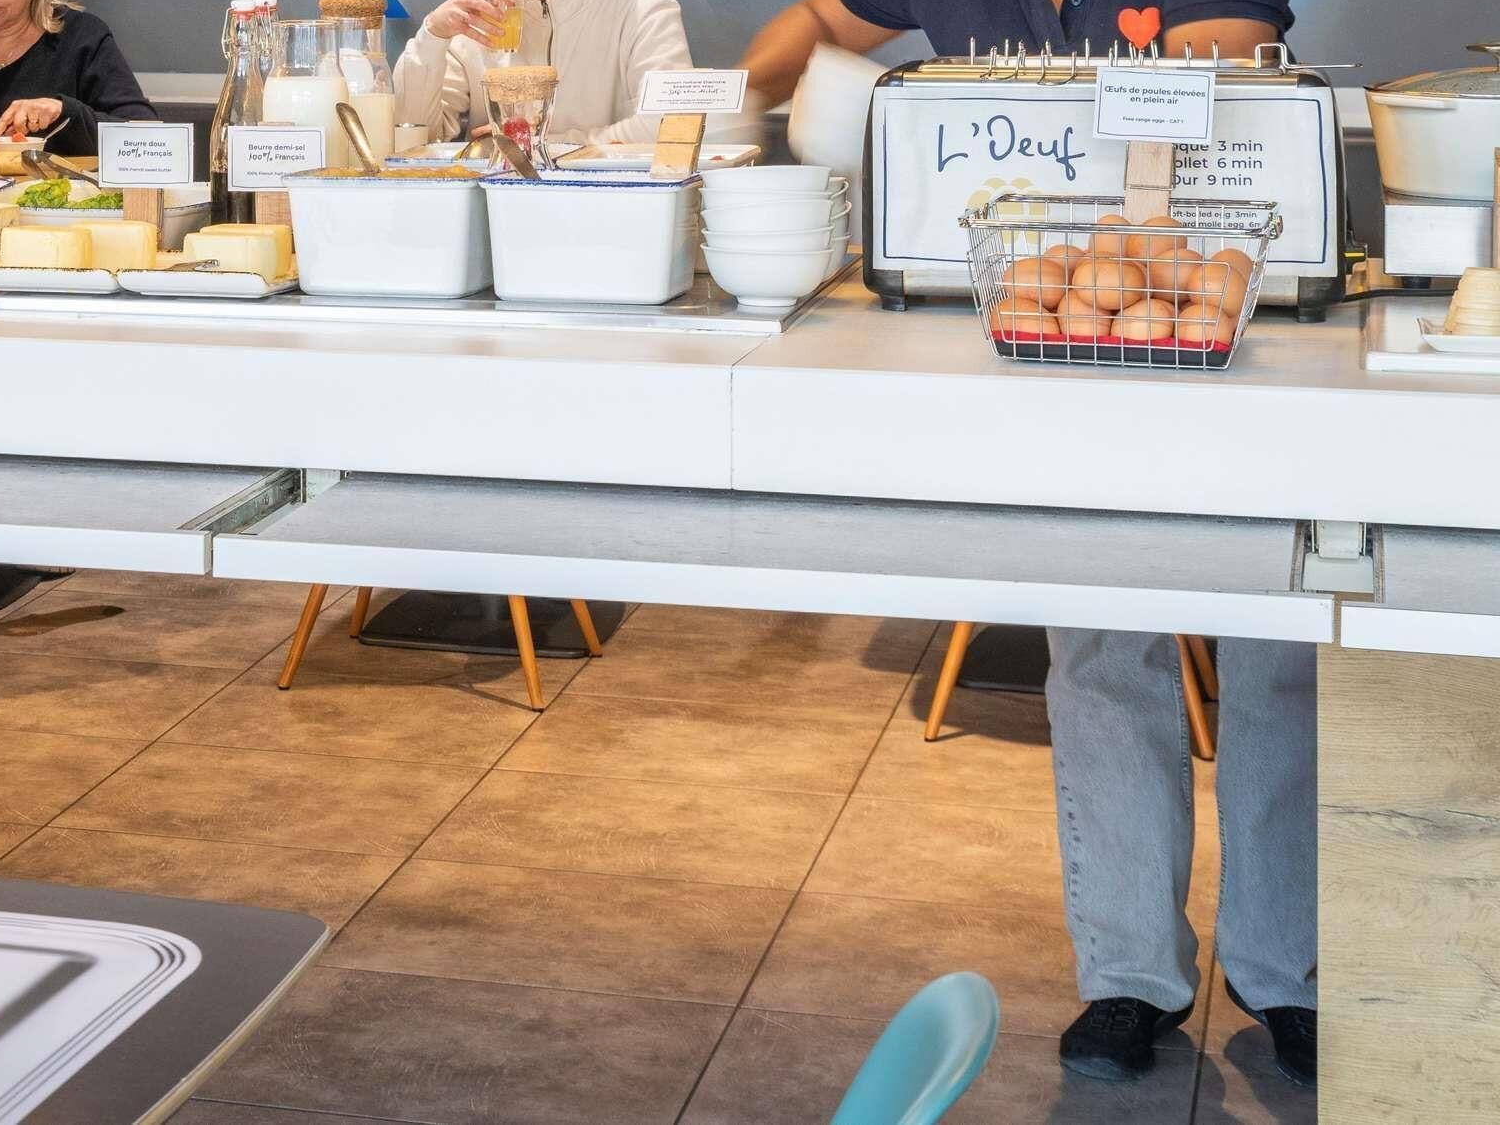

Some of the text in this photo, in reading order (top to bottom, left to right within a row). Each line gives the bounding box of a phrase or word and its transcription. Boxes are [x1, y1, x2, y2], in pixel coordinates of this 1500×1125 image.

[1104, 85, 1206, 97] Œufs de poules élevées
[1143, 96, 1165, 104] plein
[117, 147, 173, 158] 100% Français
[1176, 140, 1263, 154] que 3 min
[275, 153, 306, 162] Français
[1175, 157, 1263, 169] ollet 6 min
[1207, 174, 1217, 186] 9
[1222, 174, 1253, 186] min
